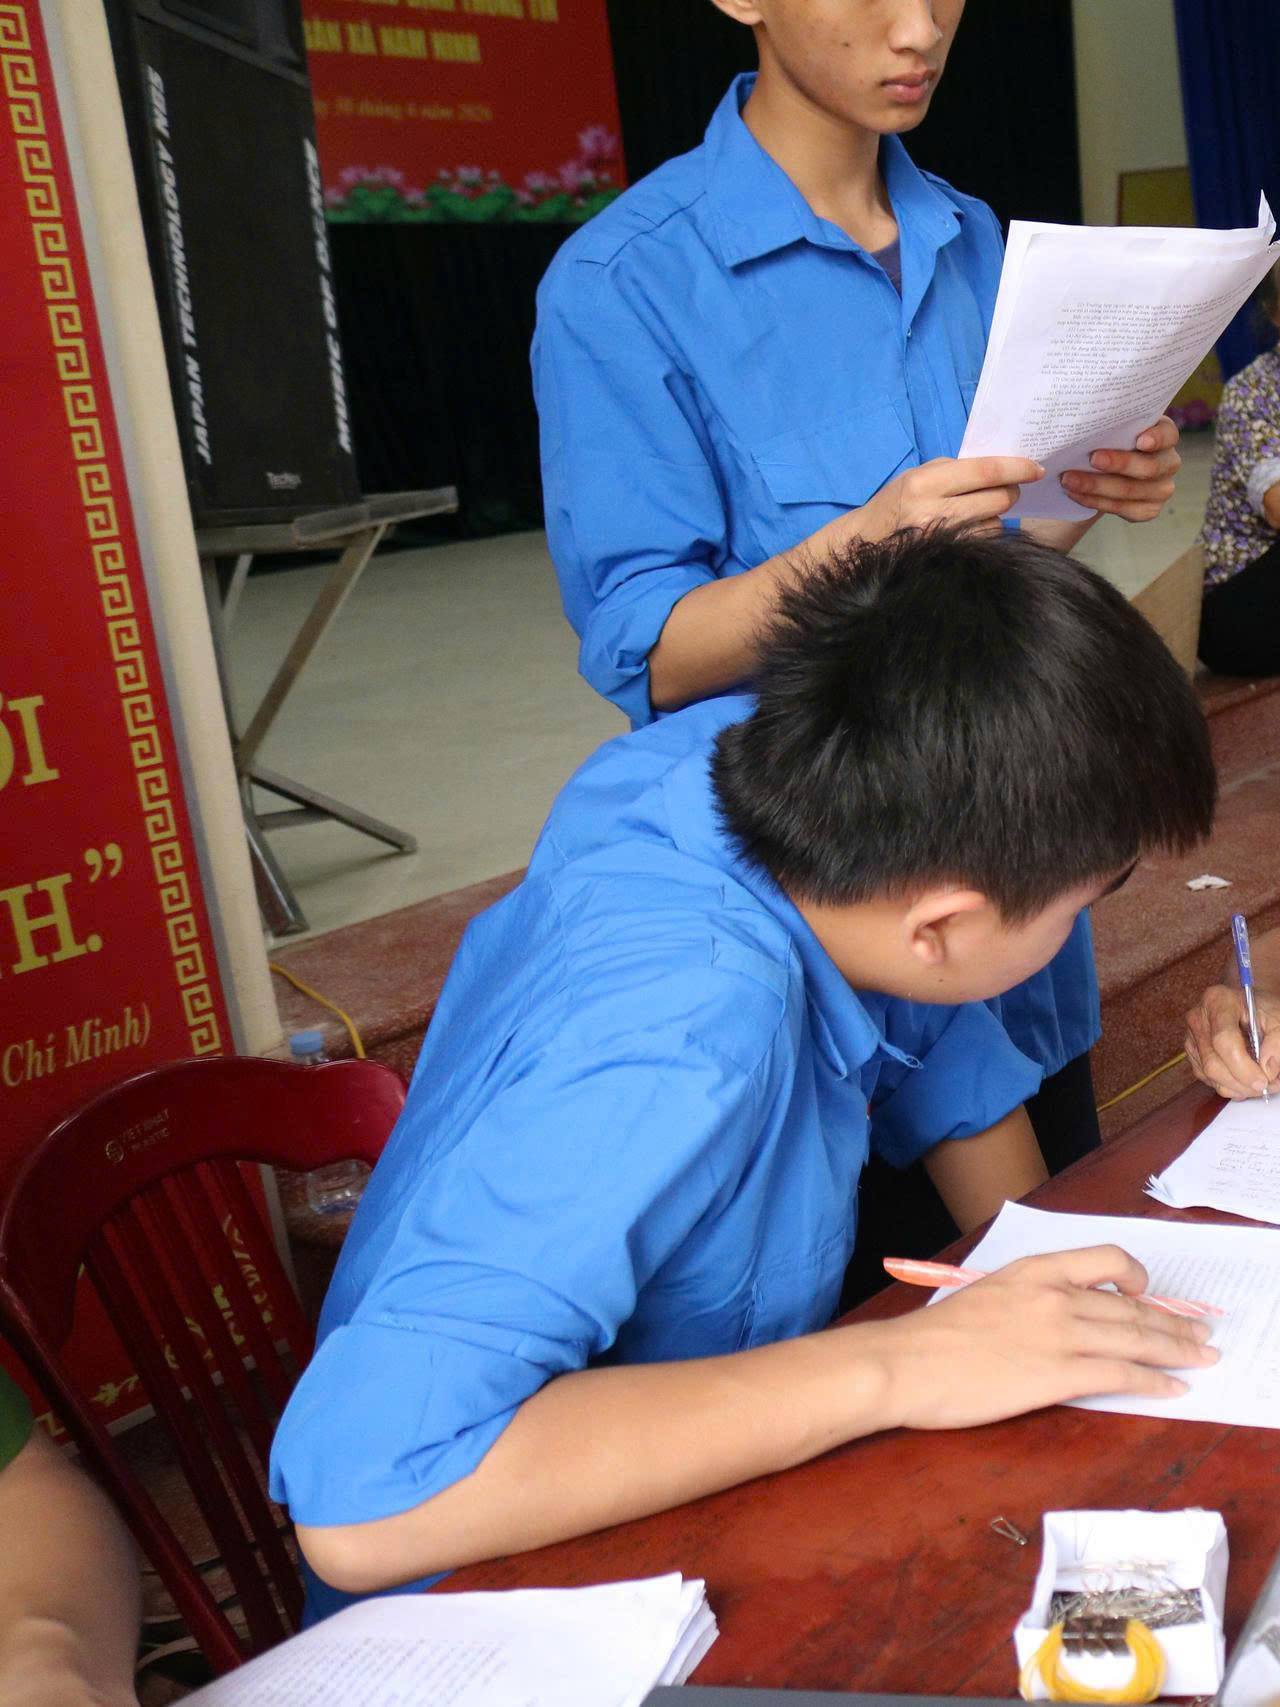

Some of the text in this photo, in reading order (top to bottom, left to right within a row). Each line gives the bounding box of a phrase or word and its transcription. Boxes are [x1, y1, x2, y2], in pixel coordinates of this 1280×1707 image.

[157, 138, 197, 348] TECHNOLOGY
[186, 353, 213, 466] JAPAN
[326, 332, 352, 455] MUSIC
[0, 842, 123, 976] H.”
[2, 1002, 151, 1087] Chí Minh)
